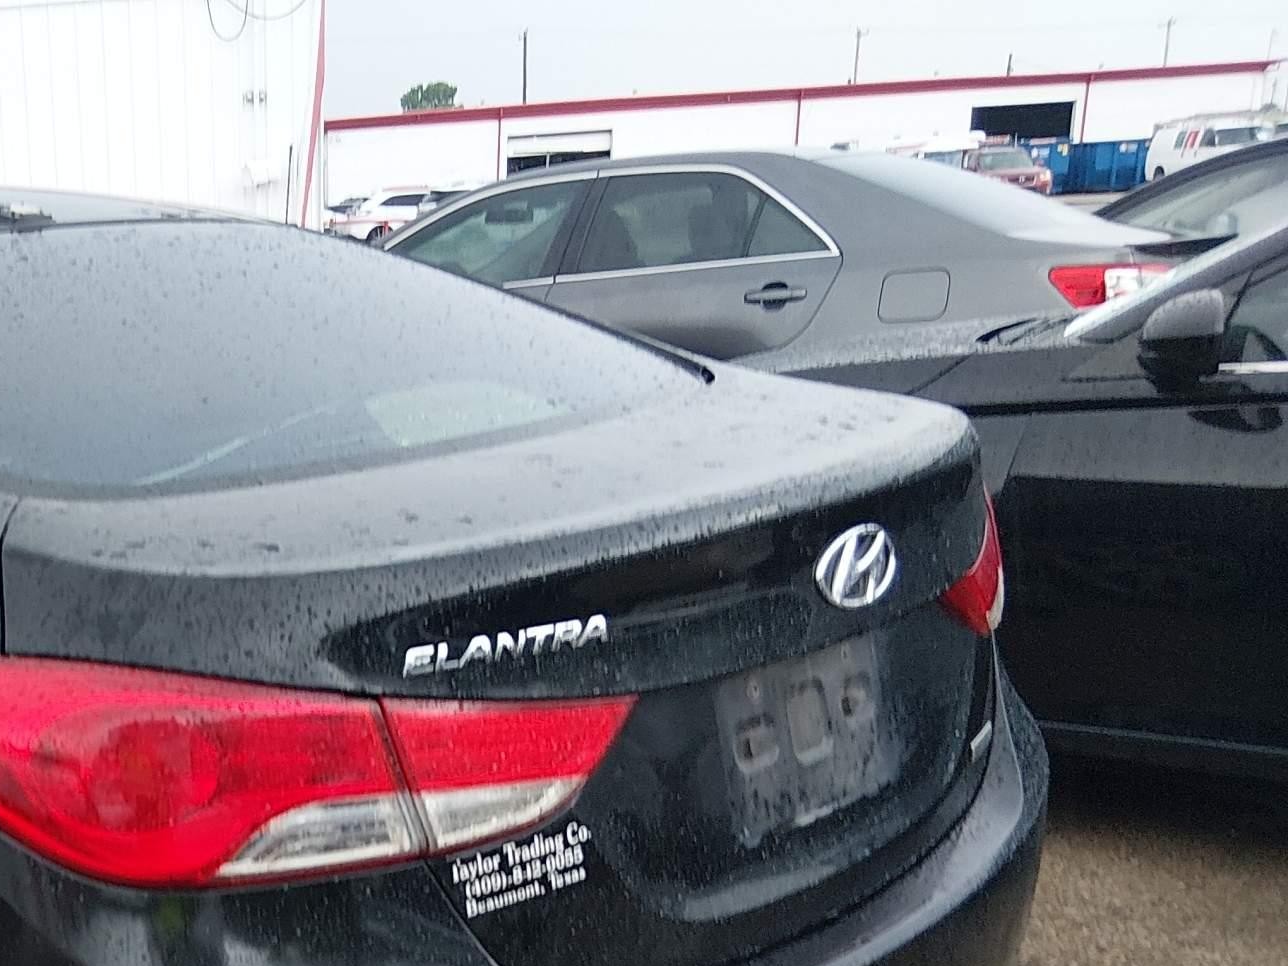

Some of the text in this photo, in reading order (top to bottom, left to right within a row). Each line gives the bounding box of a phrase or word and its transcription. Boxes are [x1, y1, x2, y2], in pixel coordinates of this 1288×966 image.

[403, 614, 608, 679] ELANTRA
[452, 852, 501, 884] Taylor
[503, 832, 565, 868] Trading
[547, 866, 587, 891] Texas
